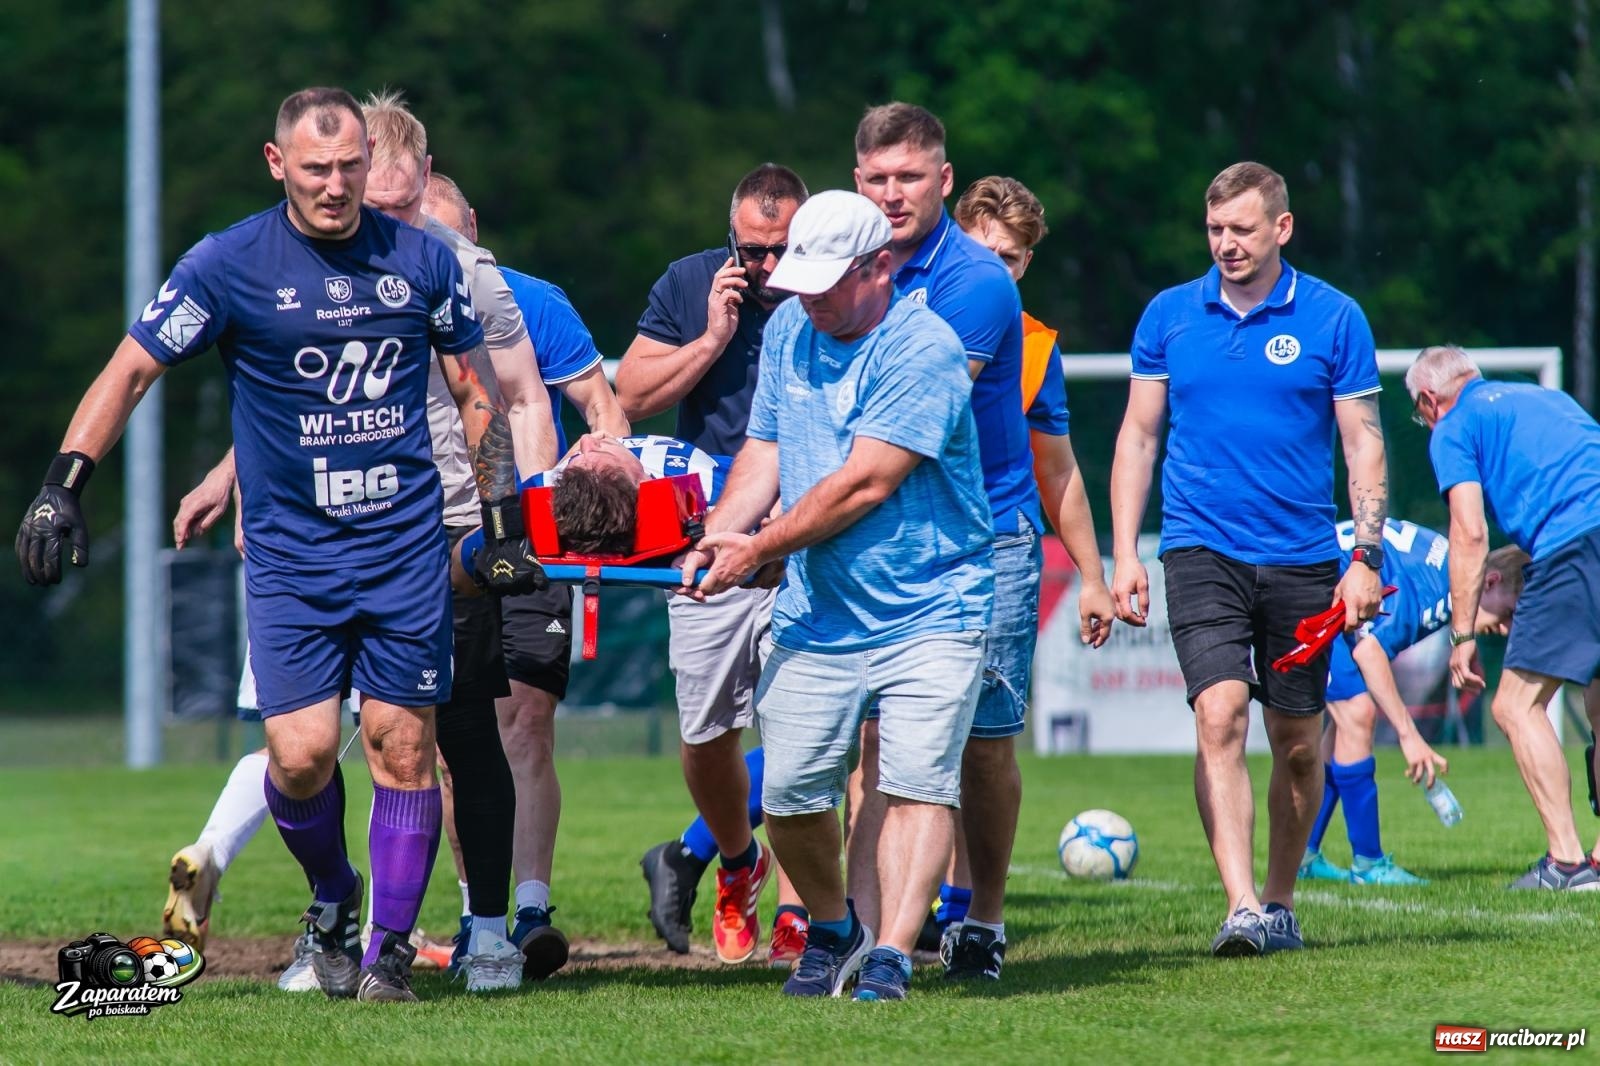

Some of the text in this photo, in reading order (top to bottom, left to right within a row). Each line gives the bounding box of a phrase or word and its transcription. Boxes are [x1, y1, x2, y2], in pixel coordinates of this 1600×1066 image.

[316, 305, 372, 320] Racibórz
[299, 404, 404, 435] WI-TECH
[300, 425, 406, 446] BRAMY I OGRODZENIA
[325, 500, 393, 517] Bruki Machura
